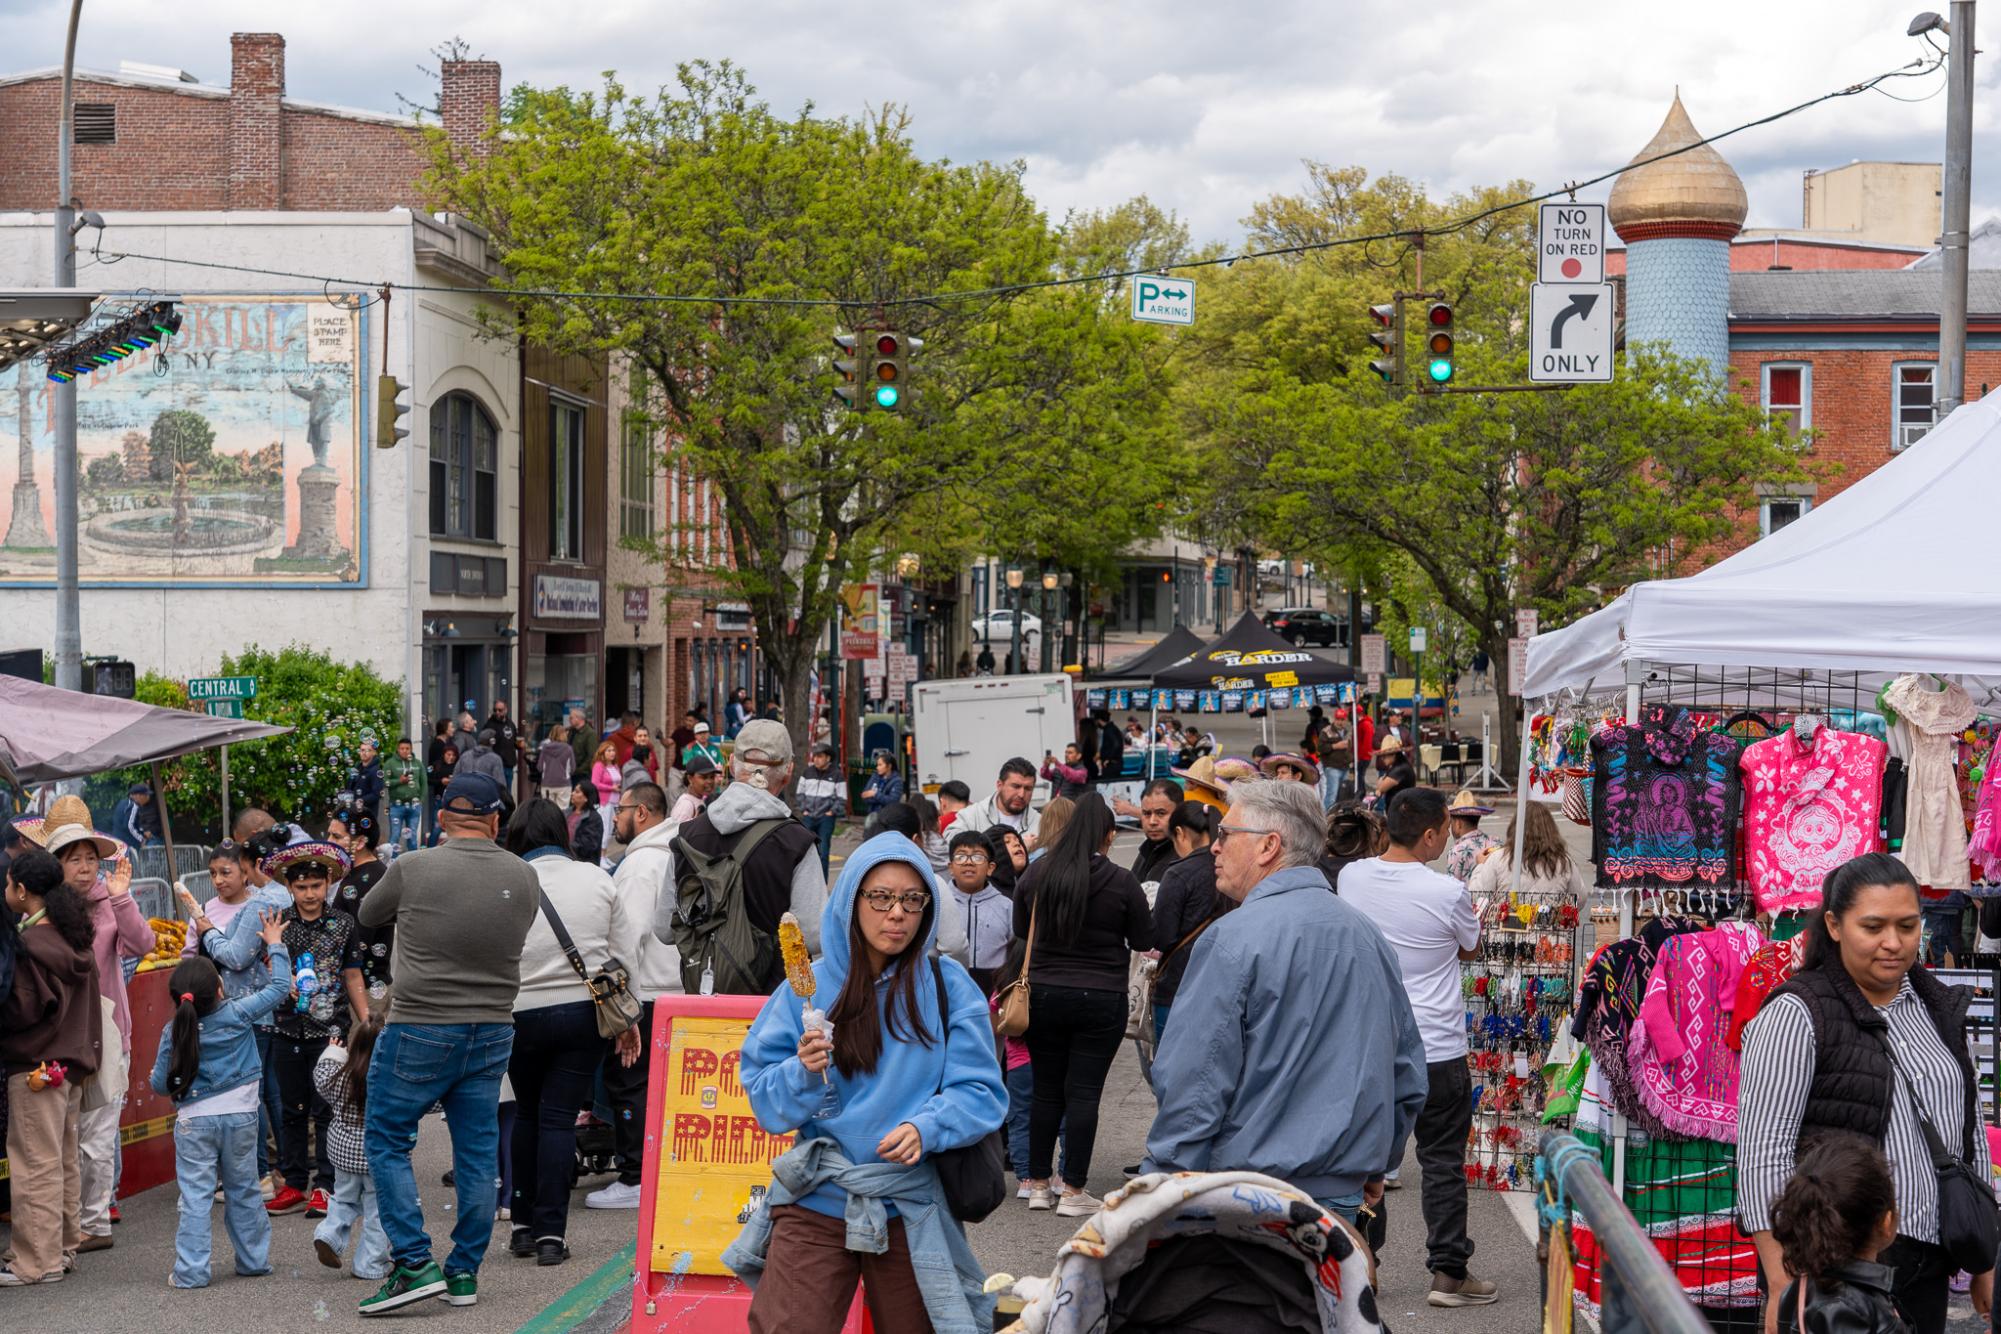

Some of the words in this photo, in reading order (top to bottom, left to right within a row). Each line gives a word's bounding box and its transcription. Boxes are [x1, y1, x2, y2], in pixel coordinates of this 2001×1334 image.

[1558, 209, 1587, 225] NO
[1554, 228, 1591, 240] TURN
[1546, 243, 1564, 256] ON
[1571, 243, 1598, 256] RED
[313, 317, 347, 326] PLACE
[313, 327, 348, 336] STAMP
[318, 338, 342, 346] HERE
[1542, 354, 1600, 373] ONLY
[1226, 653, 1312, 666] HARDER
[190, 679, 243, 697] CENTRAL
[1218, 679, 1254, 690] HARDER
